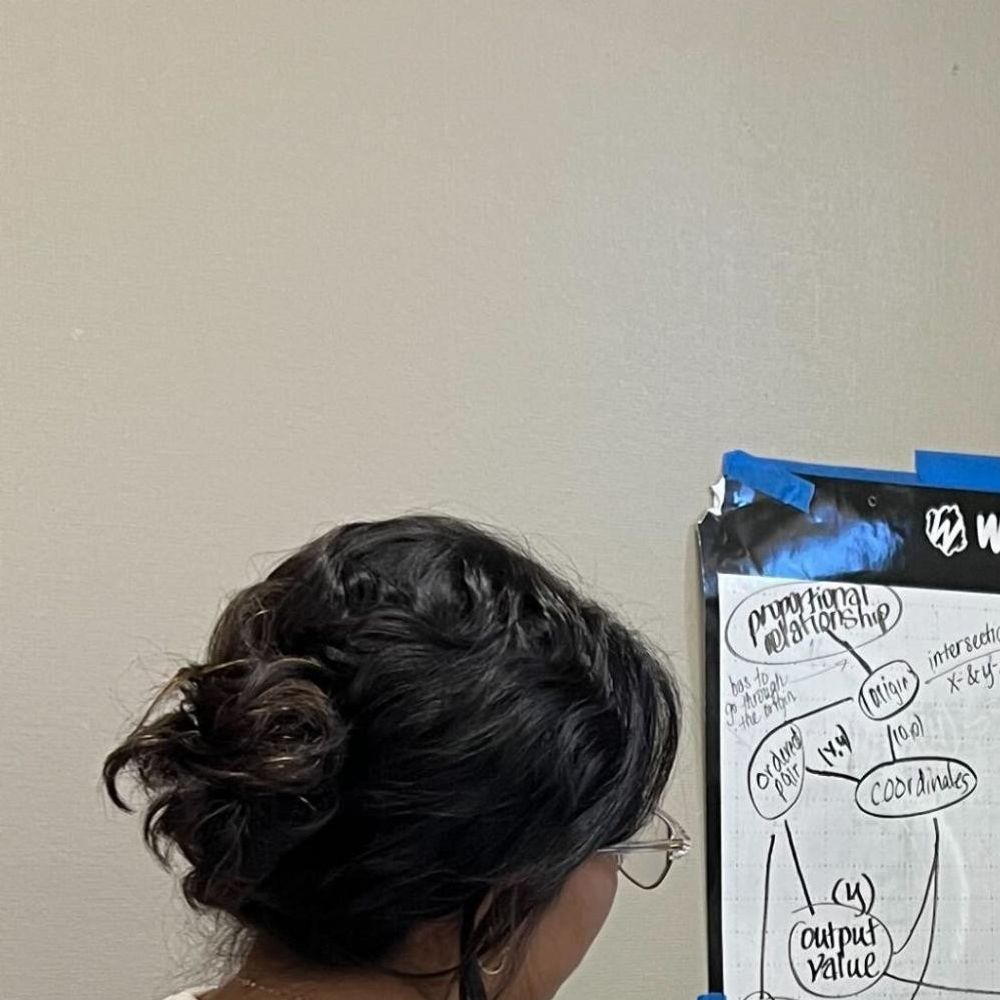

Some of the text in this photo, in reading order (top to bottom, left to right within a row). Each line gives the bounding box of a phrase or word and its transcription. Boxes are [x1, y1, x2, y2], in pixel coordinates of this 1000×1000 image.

[747, 585, 869, 648] proportional
[764, 602, 890, 655] relationship
[775, 763, 800, 803] pair
[870, 762, 970, 806] coordinates
[832, 873, 875, 917] (y)
[801, 918, 879, 954] output
[808, 951, 880, 982] value
